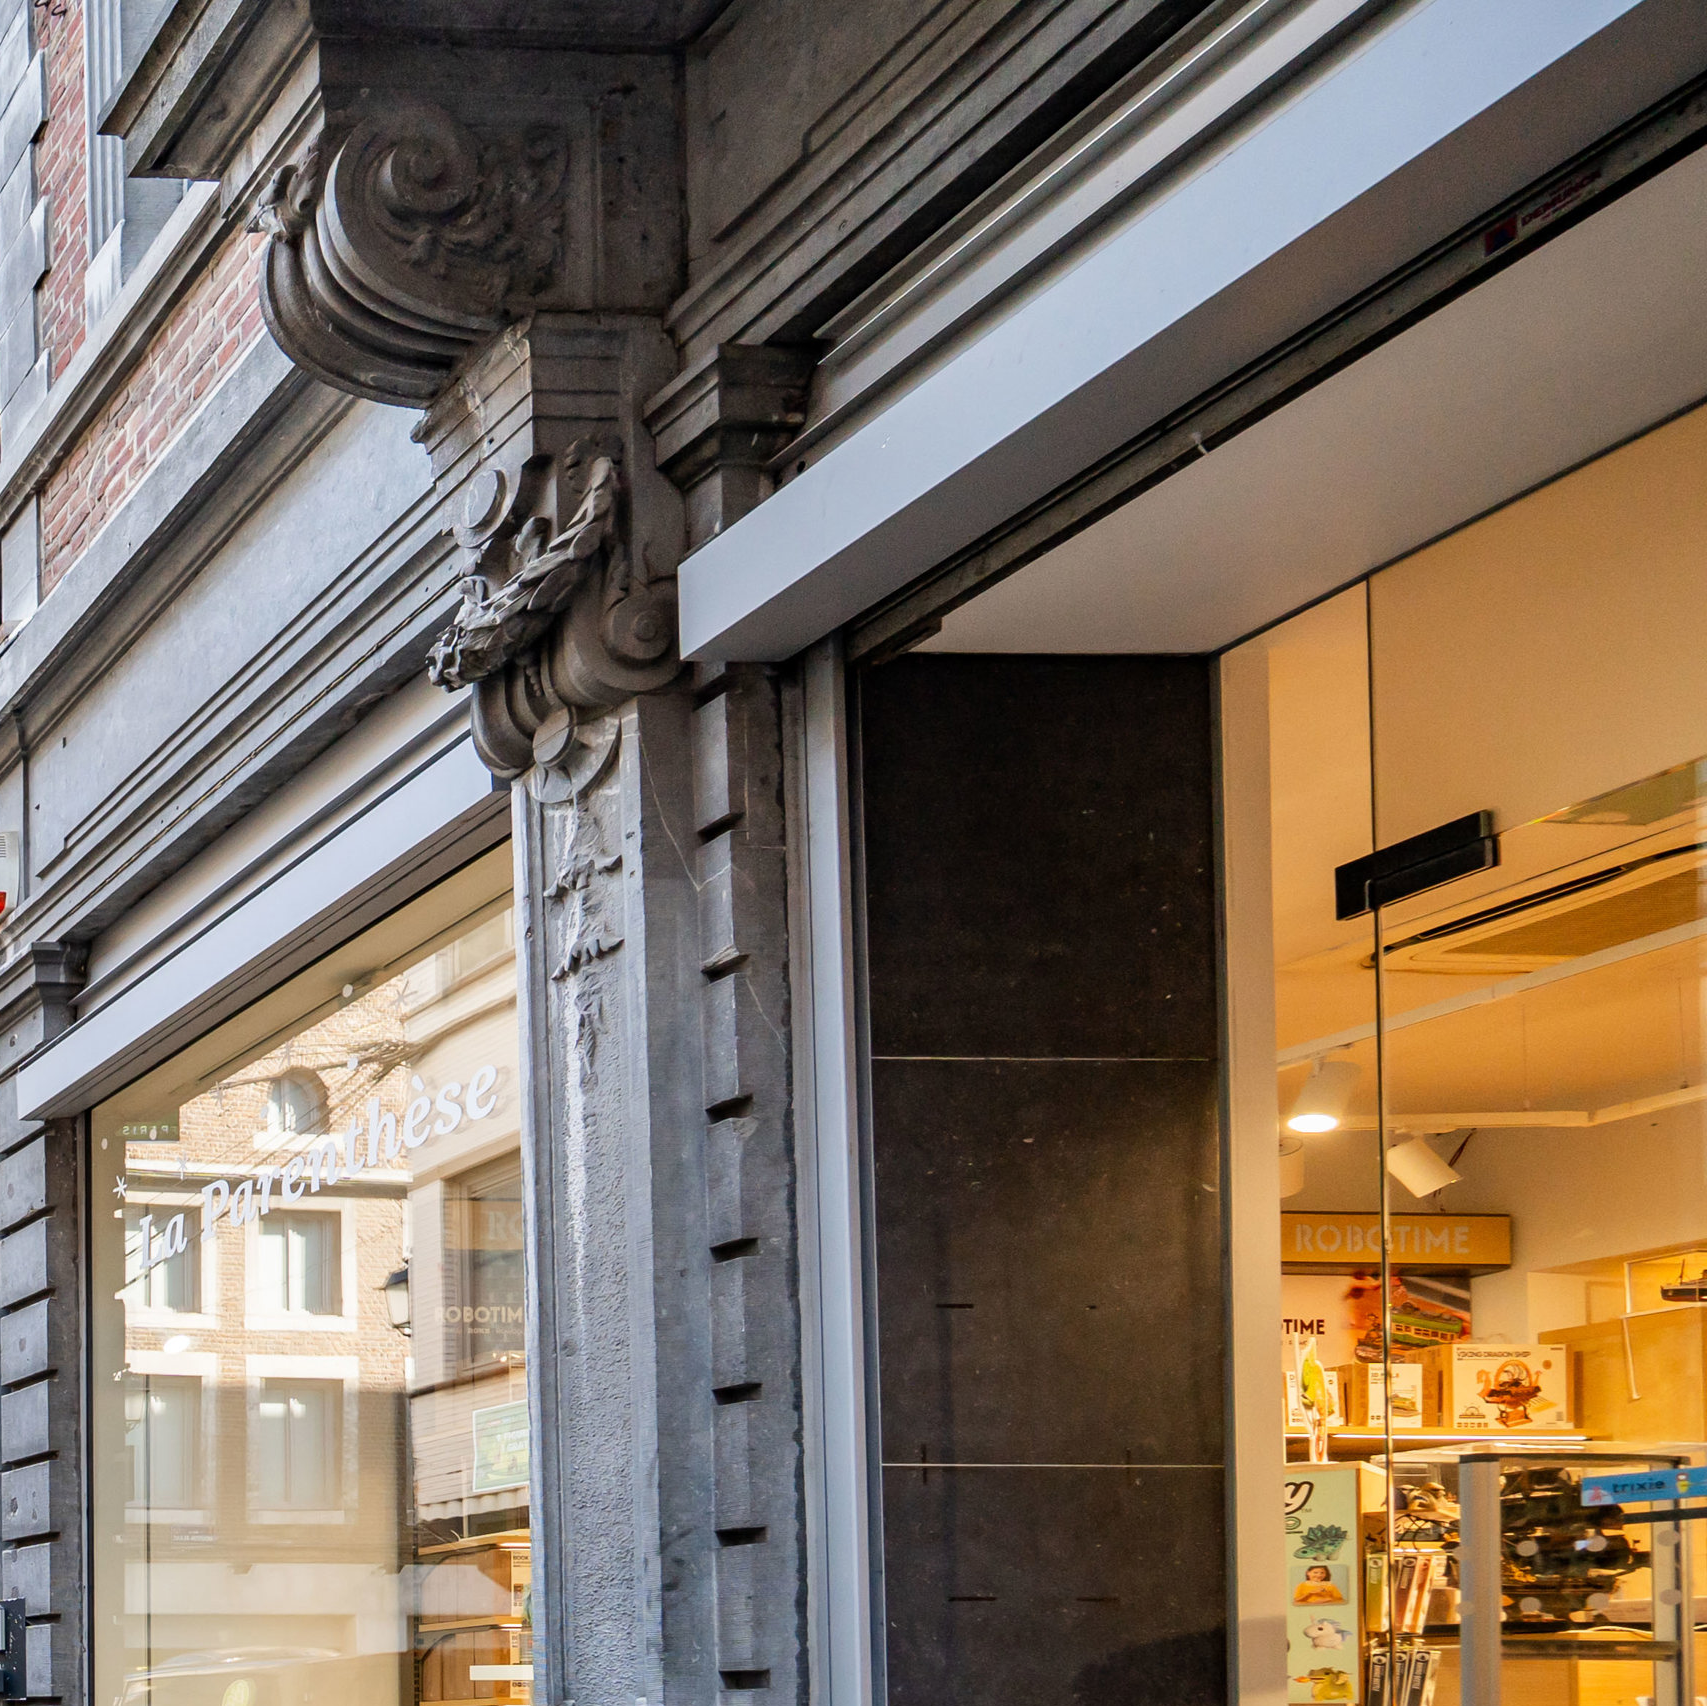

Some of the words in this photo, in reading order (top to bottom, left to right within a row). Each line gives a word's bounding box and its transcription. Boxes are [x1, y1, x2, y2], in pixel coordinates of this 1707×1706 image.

[139, 1212, 188, 1270] La
[200, 1064, 498, 1243] Parenthèse
[1294, 1223, 1471, 1255] ROBOTIME
[434, 1305, 524, 1324] ROBOTIM
[1281, 1318, 1326, 1336] TIME
[1612, 1477, 1666, 1494] trixie
